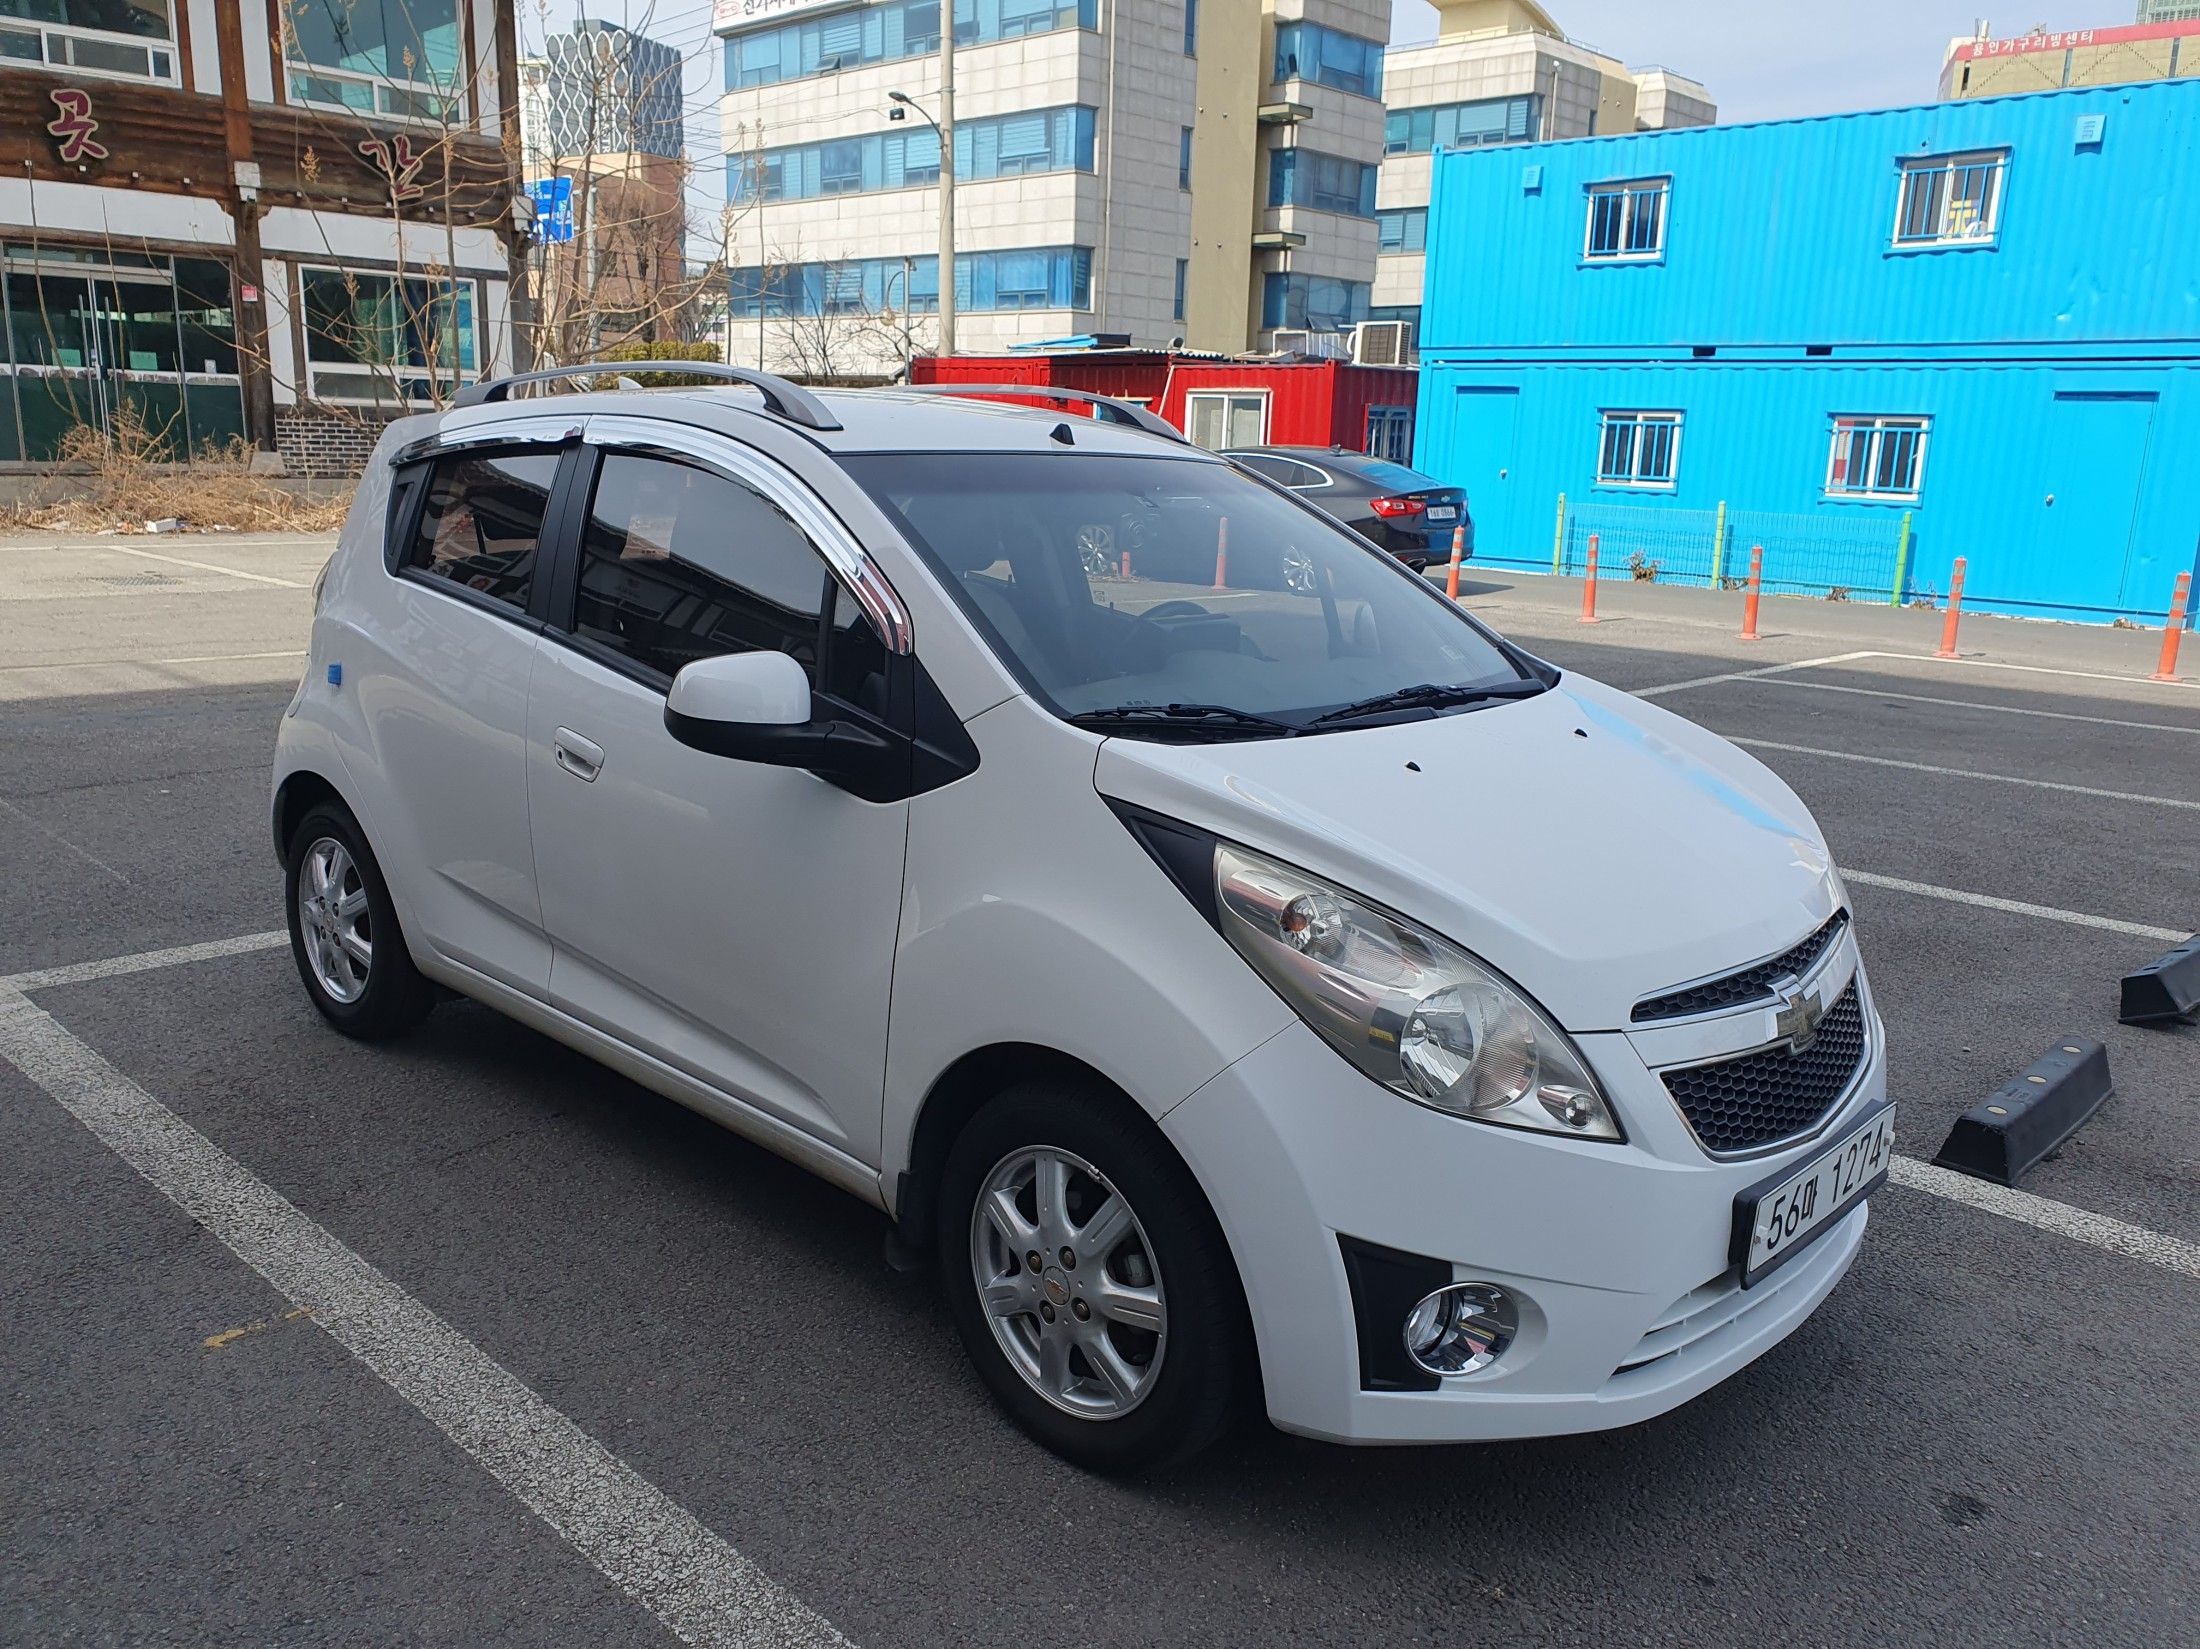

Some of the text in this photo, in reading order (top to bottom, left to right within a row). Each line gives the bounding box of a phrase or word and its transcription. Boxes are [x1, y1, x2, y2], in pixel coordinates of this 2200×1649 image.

[47, 88, 110, 162] 곳
[1767, 1121, 1884, 1250] 56마 1274
